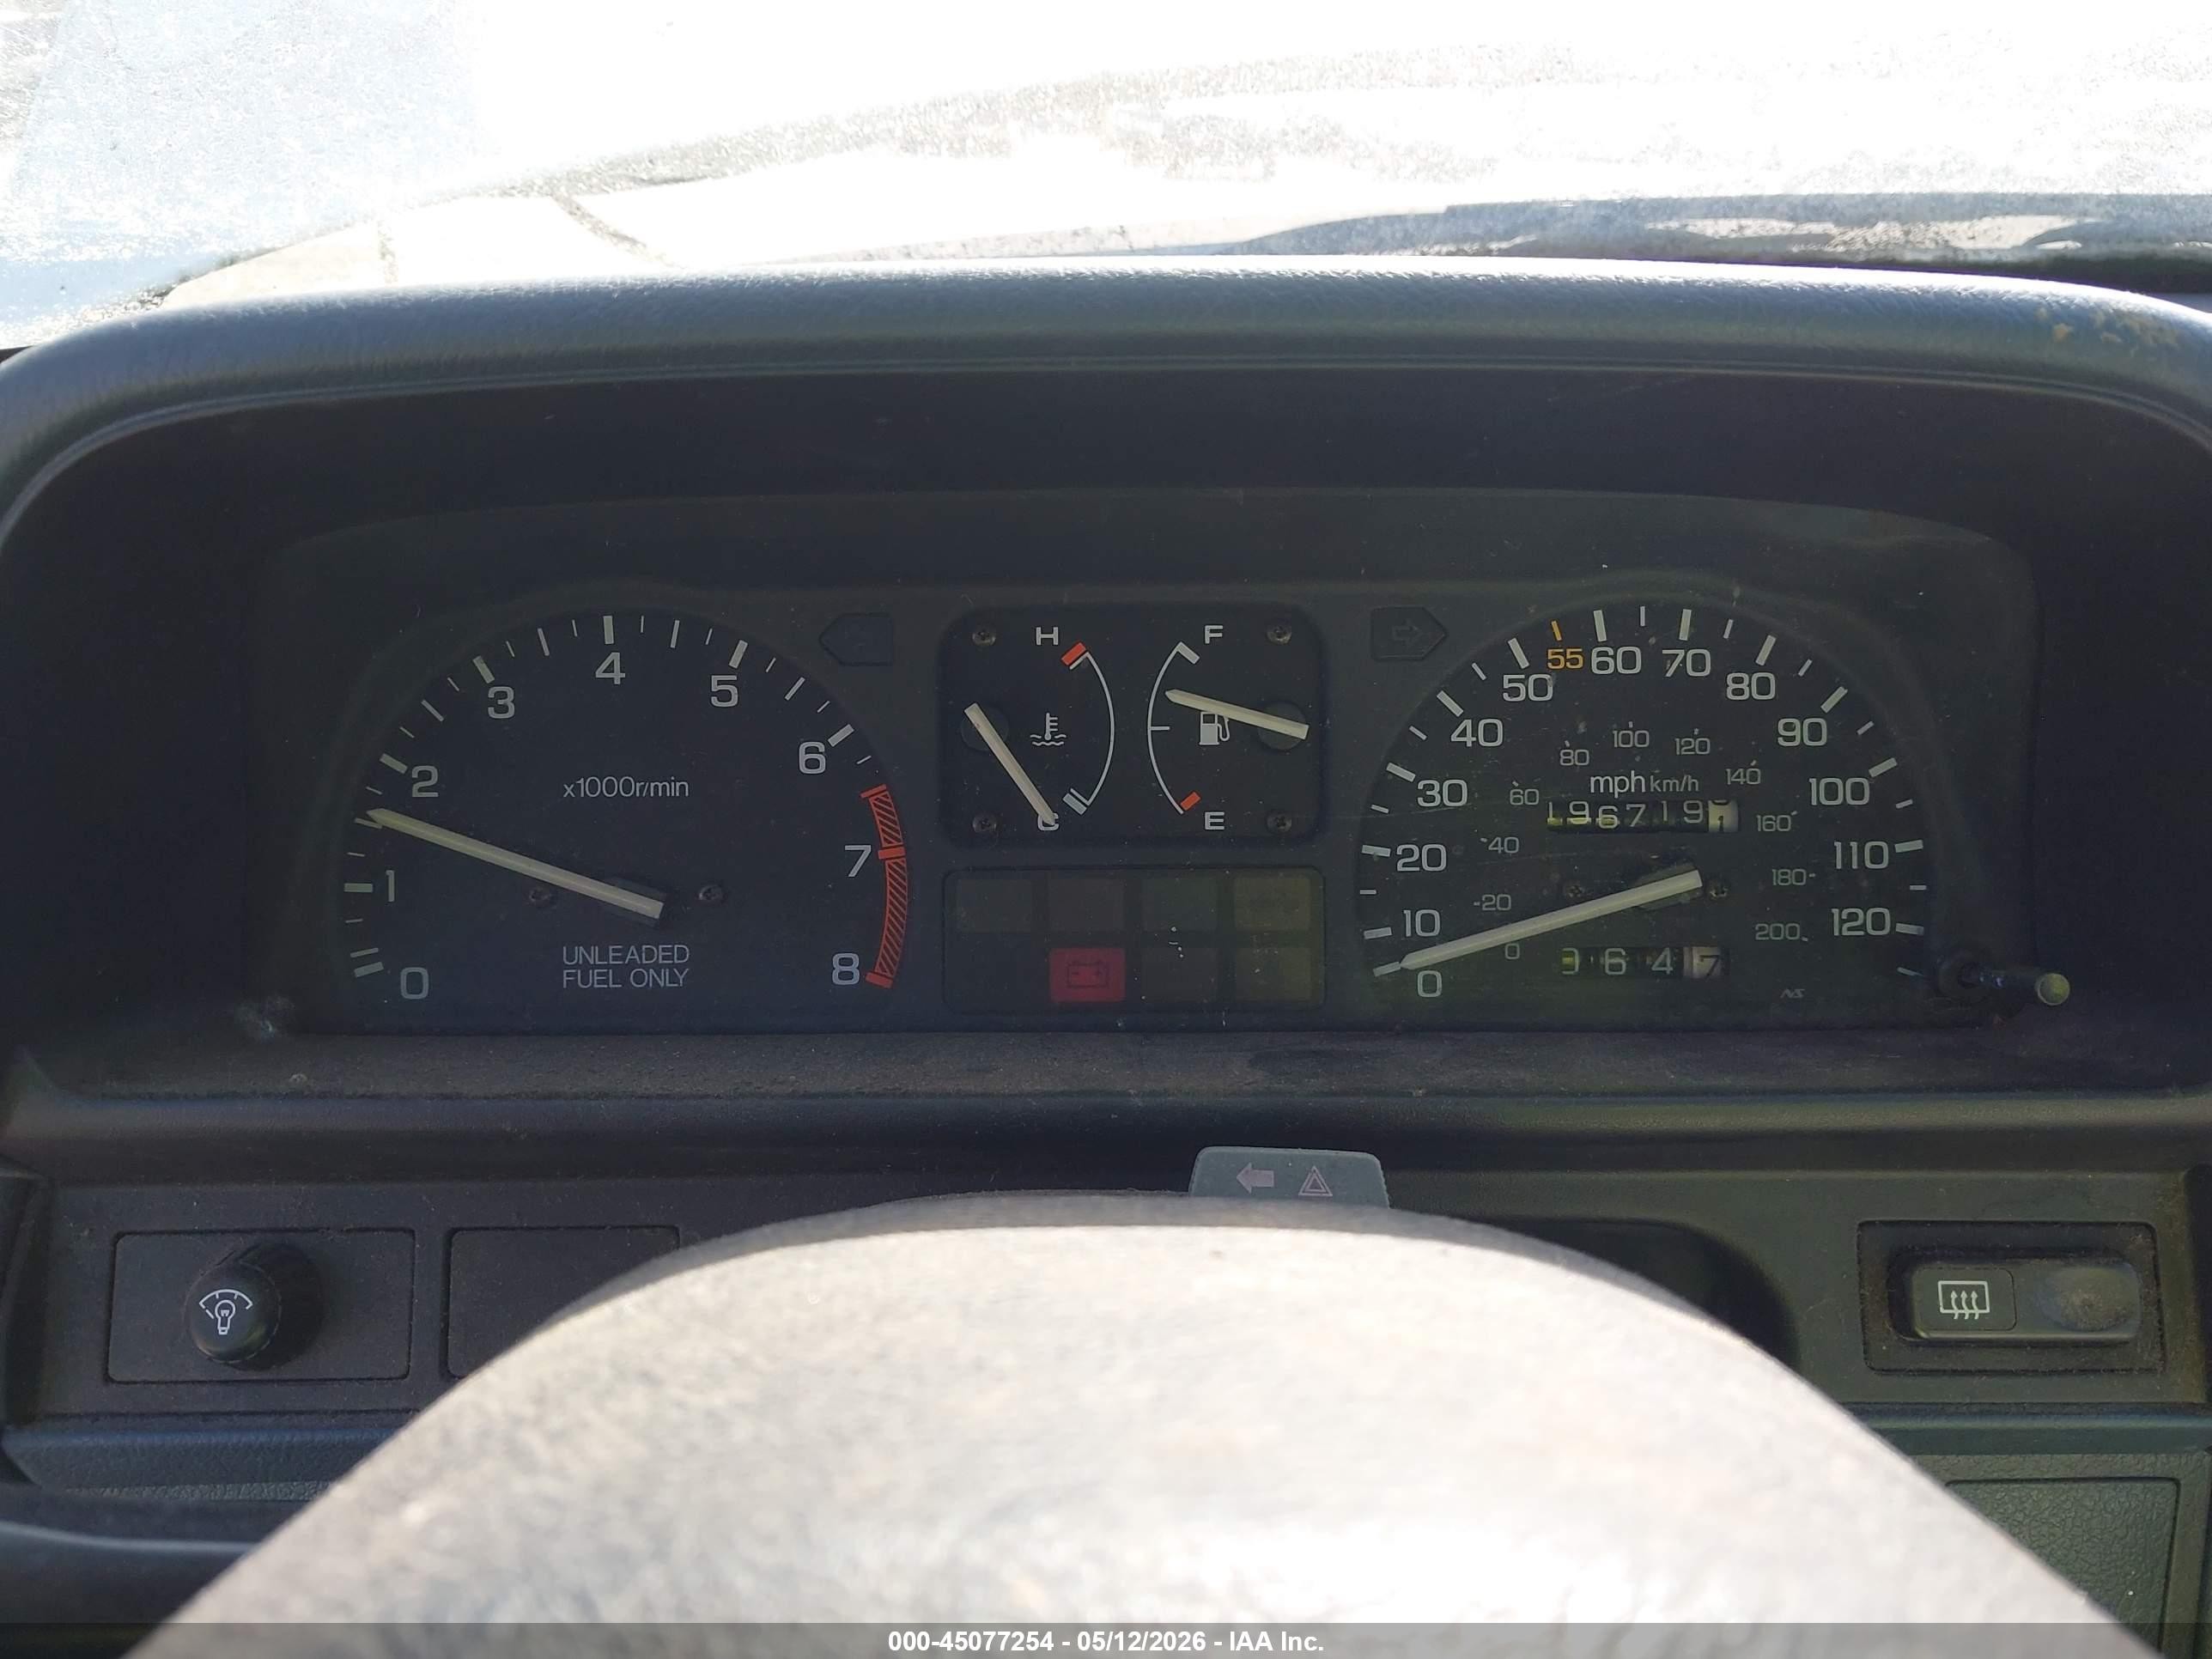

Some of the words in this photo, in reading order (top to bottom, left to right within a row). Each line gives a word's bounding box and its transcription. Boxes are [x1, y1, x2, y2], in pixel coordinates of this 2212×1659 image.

[1036, 626, 1059, 646] H
[1204, 624, 1224, 644] F
[595, 652, 626, 685] 4
[1547, 648, 1583, 669] 55
[1591, 646, 1642, 675] 60
[1662, 648, 1711, 678] 70
[711, 675, 738, 708] 5
[1503, 673, 1553, 702] 50
[1726, 672, 1776, 701] 80
[488, 686, 515, 719] 3
[1450, 714, 1504, 747] 40
[1613, 730, 1650, 748] 100
[1778, 717, 1827, 747] 90
[799, 741, 827, 775] 6
[1559, 749, 1590, 766] 80
[1675, 738, 1711, 755] 120
[411, 765, 439, 798] 2
[563, 775, 689, 798] x1000r/min
[1589, 770, 1646, 799] mph
[1650, 775, 1698, 793] km/h
[1726, 768, 1761, 785] 140
[1808, 776, 1870, 805] 100
[1416, 779, 1468, 807] 30
[1510, 784, 1540, 805] 60
[1204, 811, 1225, 830] E
[1756, 814, 1791, 832] 160
[1396, 843, 1447, 872] 20
[1488, 836, 1520, 854] 40
[1833, 841, 1889, 870] 110
[844, 844, 872, 878] 7
[386, 869, 395, 902] 1
[1771, 868, 1807, 886] 180
[1481, 894, 1512, 911] 20
[1403, 908, 1441, 937] 10
[1754, 922, 1801, 940] 200
[1831, 907, 1891, 936] 120
[562, 944, 690, 965] UNLEADED
[1504, 943, 1520, 960] 0
[400, 967, 429, 1000] 0
[562, 969, 623, 988] FUEL
[629, 968, 690, 988] ONLY
[832, 952, 860, 986] 8
[1416, 969, 1443, 998] 0
